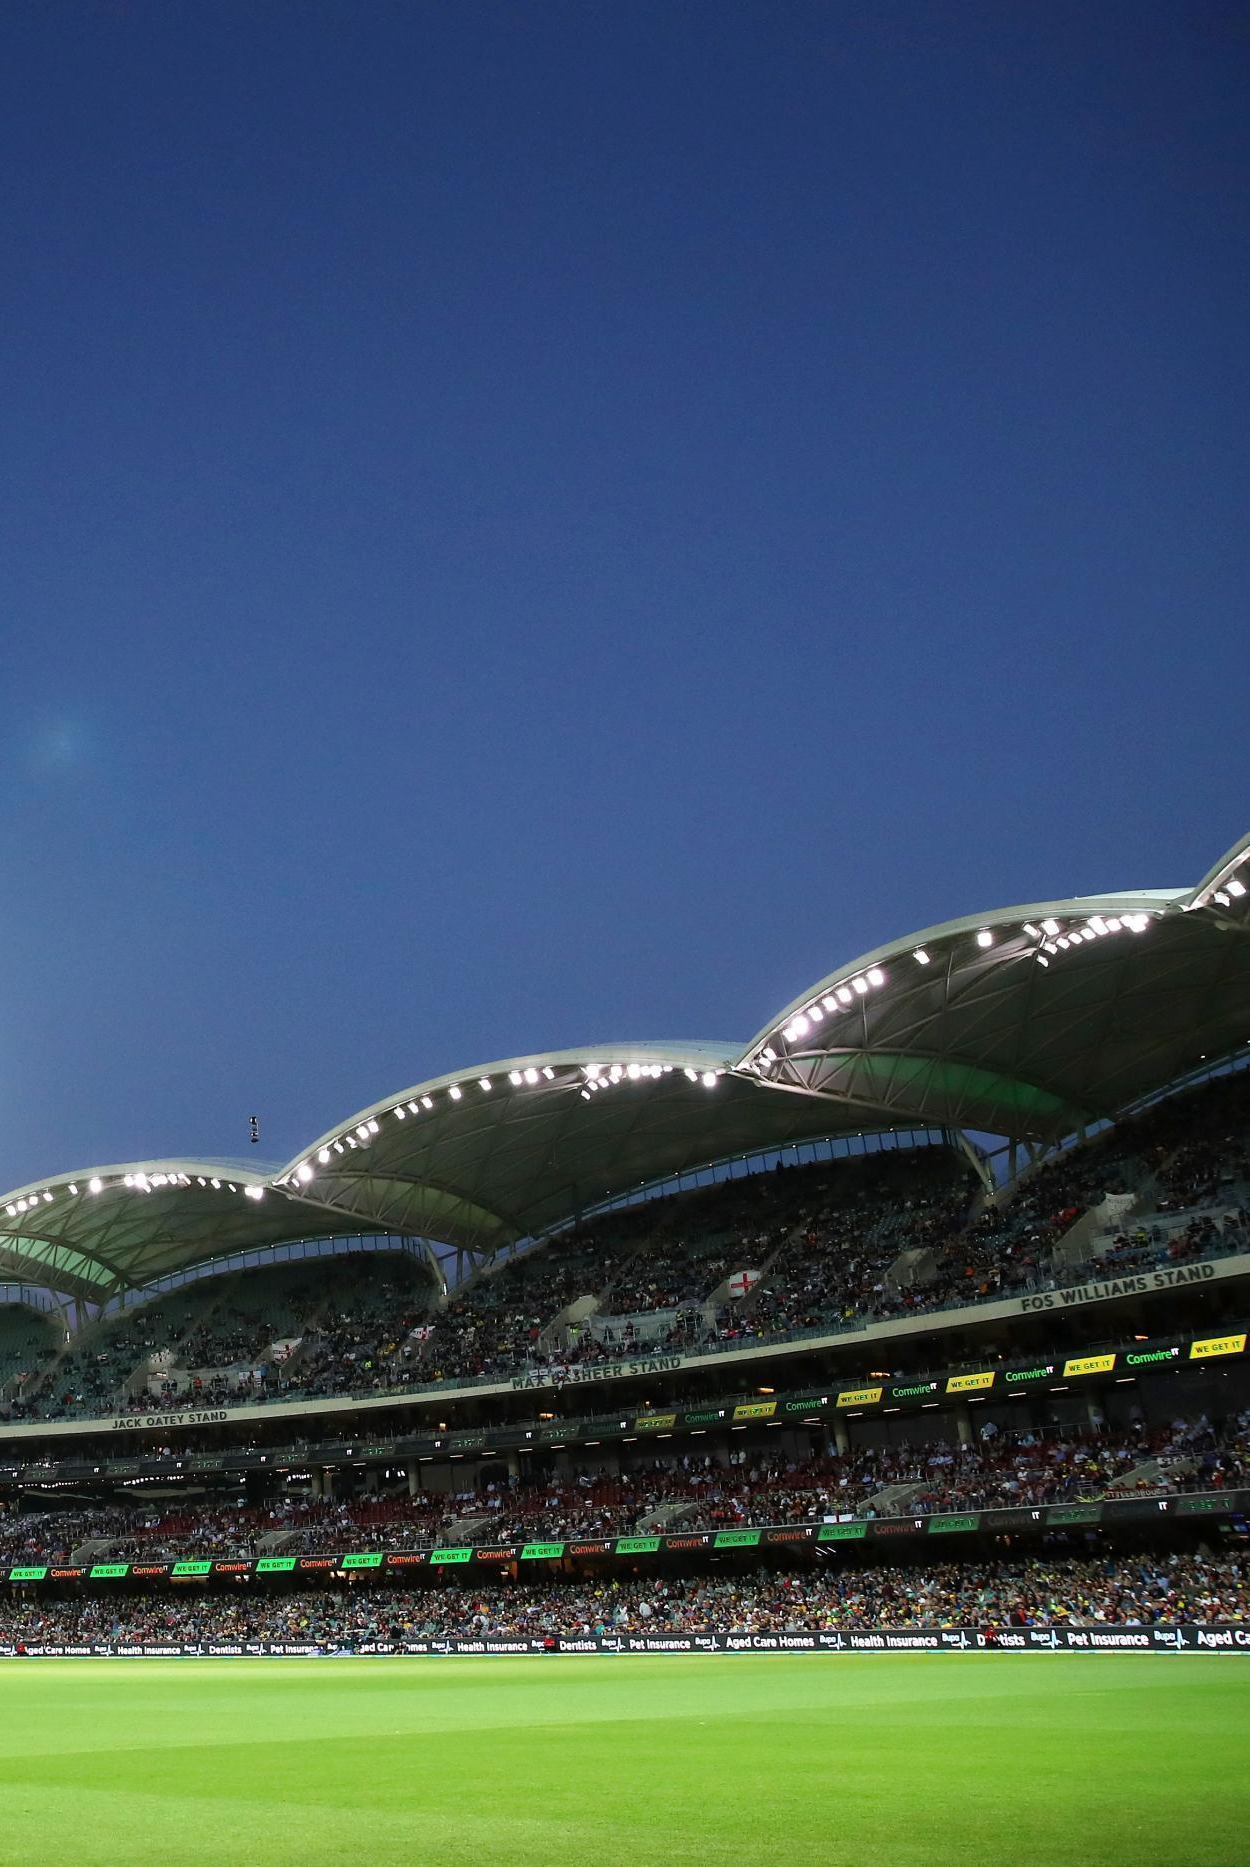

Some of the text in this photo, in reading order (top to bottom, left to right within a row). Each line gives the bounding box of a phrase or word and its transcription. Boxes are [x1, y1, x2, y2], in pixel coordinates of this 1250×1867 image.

[1022, 1265, 1215, 1311] FOS WILLIAMS STAND
[1212, 1343, 1228, 1351] GET
[513, 1375, 545, 1390] MAX
[630, 1357, 681, 1375] STAND
[965, 1379, 980, 1387] GET
[112, 1412, 227, 1430] JACK OATEY STAND
[633, 1542, 647, 1550] GET
[851, 1635, 938, 1647] Health Insurance
[977, 1634, 1025, 1646] Dtists
[1067, 1632, 1149, 1646] Pet Insurance
[1154, 1631, 1175, 1641] Bupa
[1197, 1631, 1250, 1647] Aged Ca
[457, 1642, 528, 1651] Health Insurance
[560, 1641, 597, 1650] Dentists
[629, 1639, 691, 1649] Pet Insurance
[726, 1636, 815, 1649] Aged Care Homes
[45, 1646, 63, 1654] Care
[64, 1646, 91, 1654] Homes
[117, 1646, 180, 1654] Health Insurance
[209, 1646, 242, 1654] Dentists
[270, 1645, 284, 1654] Pet
